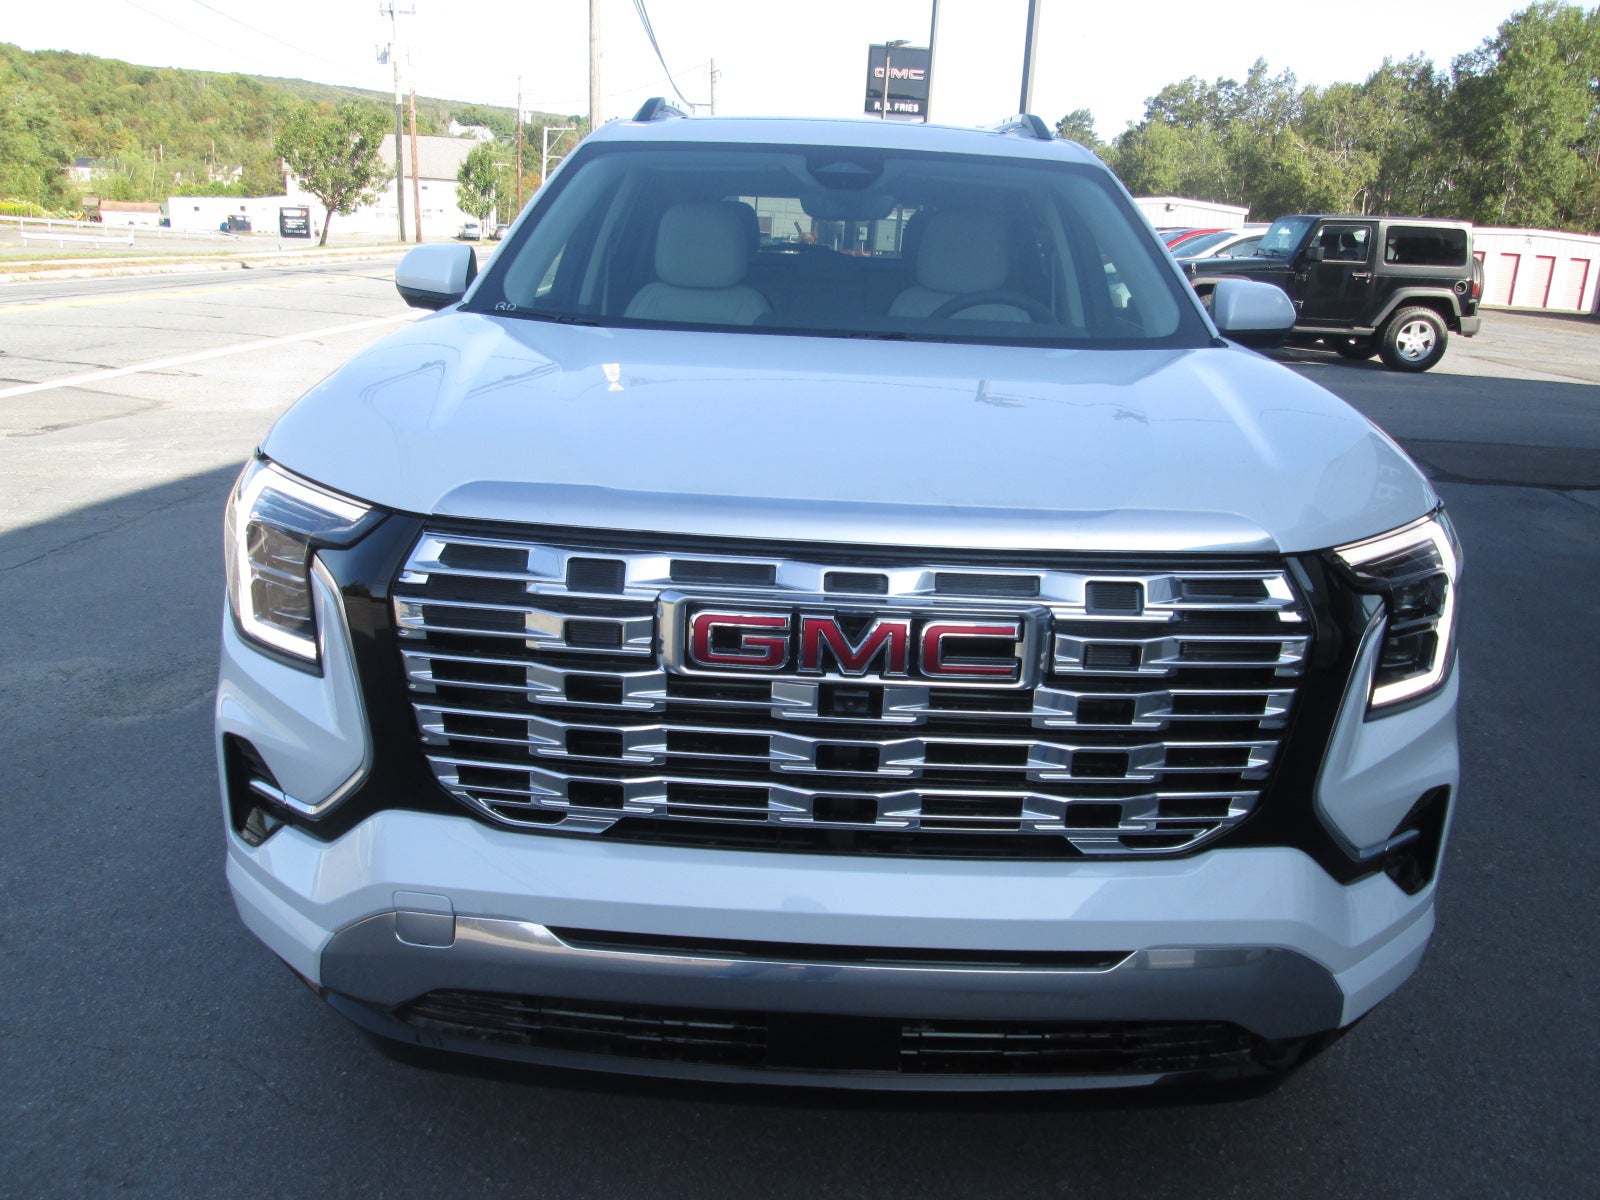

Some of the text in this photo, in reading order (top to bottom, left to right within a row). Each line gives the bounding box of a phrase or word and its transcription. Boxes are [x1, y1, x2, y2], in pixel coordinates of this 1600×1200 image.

[874, 66, 924, 80] GMC
[894, 103, 919, 112] FRIES
[689, 609, 1023, 680] GMC
